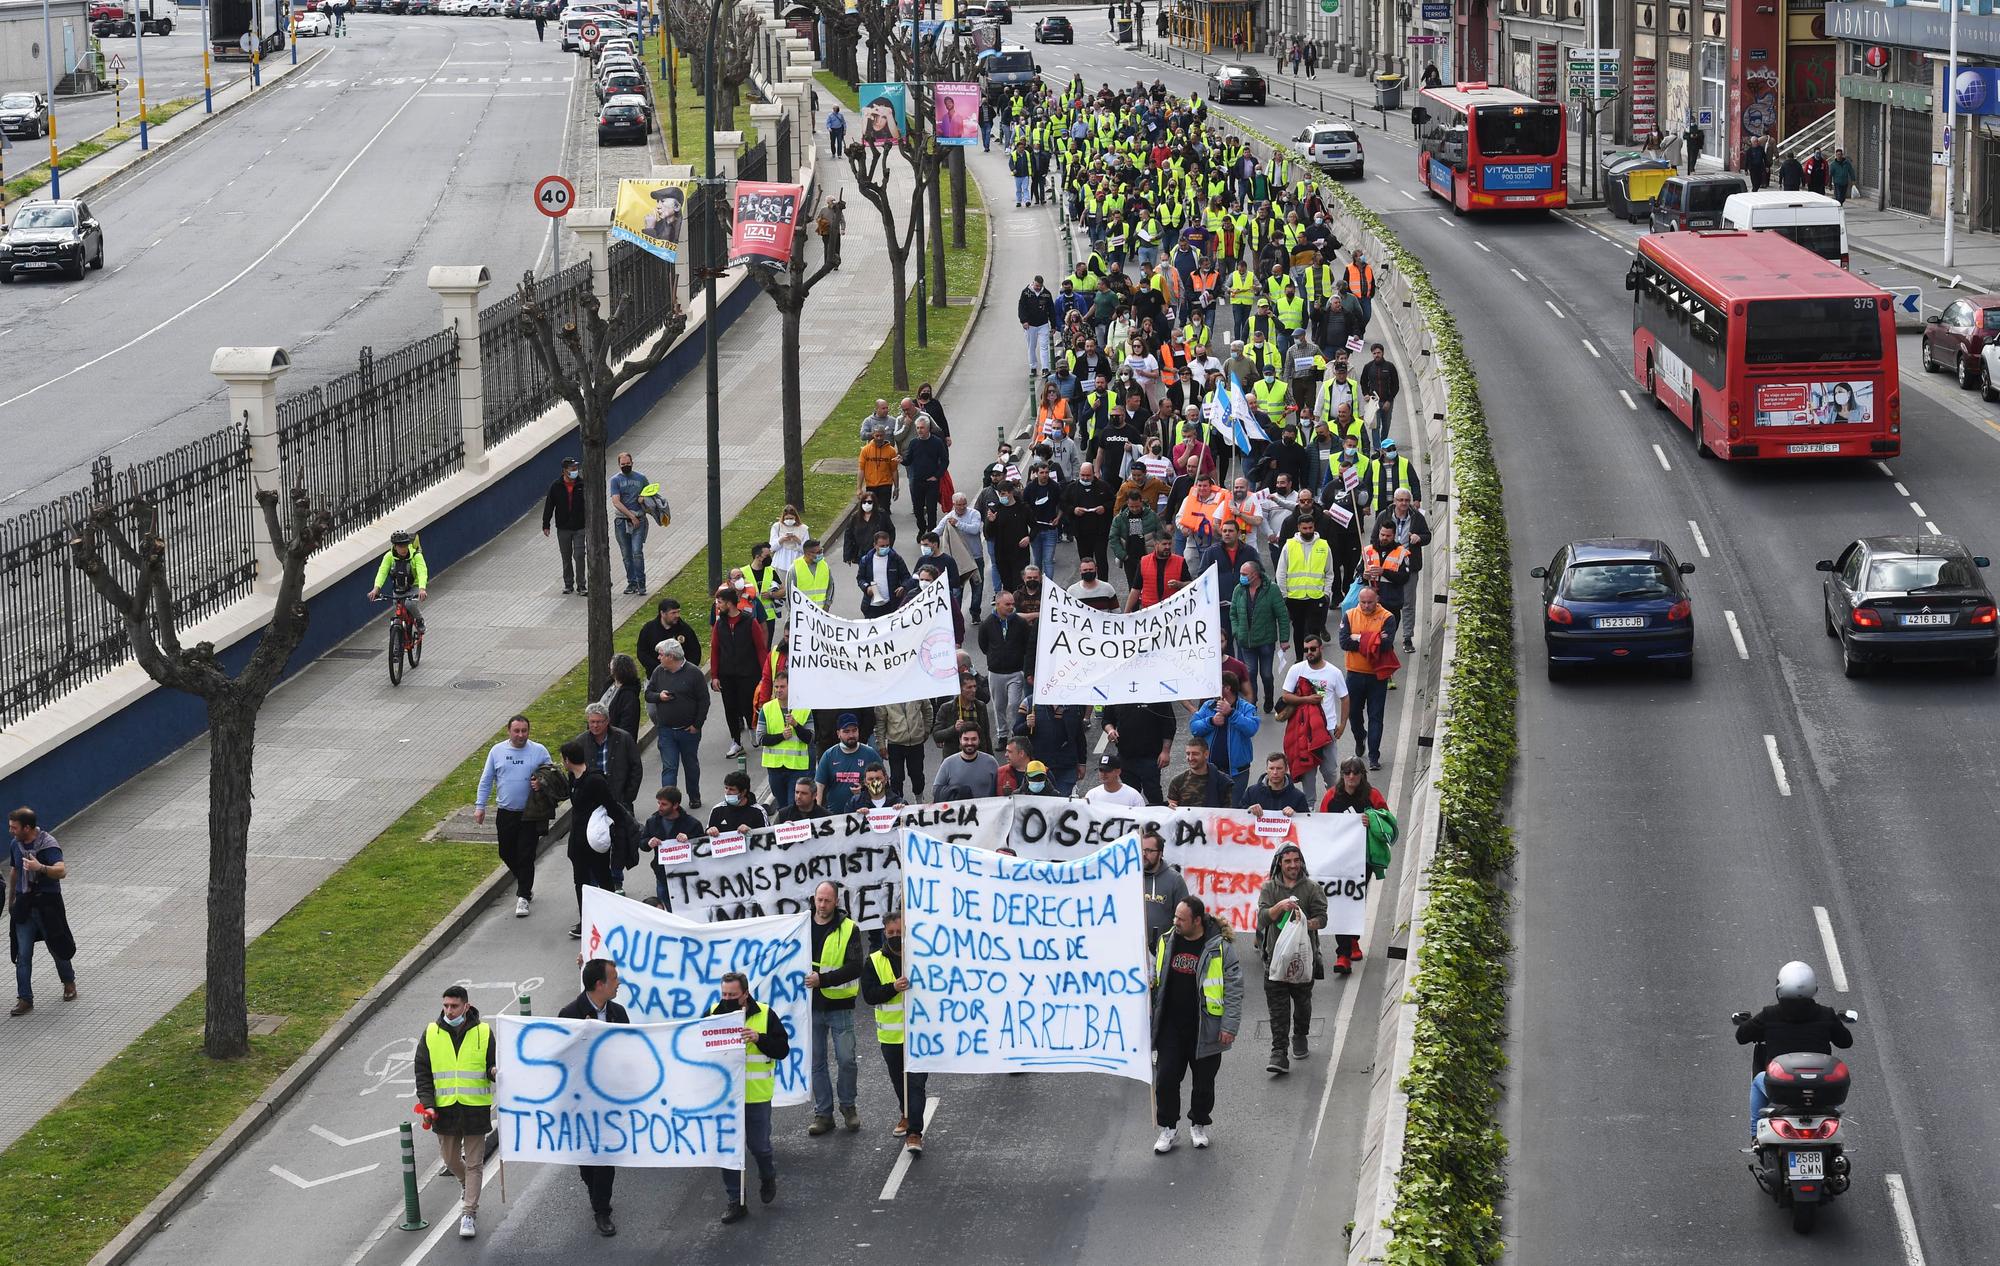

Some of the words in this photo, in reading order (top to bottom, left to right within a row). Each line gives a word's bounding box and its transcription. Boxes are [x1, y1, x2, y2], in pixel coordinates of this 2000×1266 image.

[584, 29, 596, 37] 40
[936, 84, 978, 92] CAMILO
[1513, 107, 1524, 115] 2A
[1485, 165, 1552, 174] VITALDENT
[541, 189, 567, 204] 40
[747, 226, 772, 237] IZAL
[734, 256, 750, 266] MAIO
[1854, 298, 1874, 309] 375
[1791, 445, 1809, 453] 6092
[792, 590, 801, 605] O
[795, 611, 860, 642] FUNDEN
[866, 625, 879, 638] A
[890, 596, 949, 632] FLOTA
[1050, 608, 1094, 633] ESTA
[1102, 621, 1125, 635] EN
[1134, 598, 1197, 634] MADRID
[1600, 617, 1624, 628] 1523
[1624, 617, 1643, 628] CJB
[1907, 614, 1929, 625] 4216
[1930, 614, 1950, 625] BJL
[1050, 630, 1072, 655] A
[1078, 620, 1208, 659] GOBERNAR
[794, 634, 803, 652] E
[810, 635, 850, 659] UNHA
[857, 639, 895, 659] MAN
[865, 662, 877, 673] A
[884, 648, 918, 670] BOTA
[1041, 658, 1079, 696] GASOIL
[893, 804, 980, 828] ALICIA
[776, 824, 810, 833] GOBIERNO
[1021, 807, 1048, 844] O
[1175, 819, 1207, 846] DA
[711, 836, 744, 846] GOBIERNO
[779, 832, 809, 841] DIMISIÓN
[660, 844, 690, 853] GOBIERNO
[715, 845, 743, 854] DIMISIÓN
[908, 831, 943, 868] NI
[951, 845, 983, 877] DE
[661, 853, 688, 862] DIMISIÓN
[907, 876, 940, 915] NI
[952, 887, 982, 921] DE
[993, 894, 1117, 928] DERECHA
[911, 922, 1011, 961] SOMOS
[1018, 938, 1056, 961] LOS
[1066, 935, 1089, 961] DE
[908, 964, 1007, 995] ABAJO
[1019, 972, 1036, 996] Y
[1046, 967, 1148, 996] VAMOS
[909, 998, 930, 1025] A
[939, 998, 989, 1025] POR
[909, 1031, 945, 1058] LOS
[956, 1029, 989, 1056] DE
[998, 1000, 1137, 1053] ARRIBA.
[498, 1107, 737, 1155] TRANSPORTE
[1796, 1152, 1820, 1163] 2588
[1800, 1163, 1822, 1175] GMN
